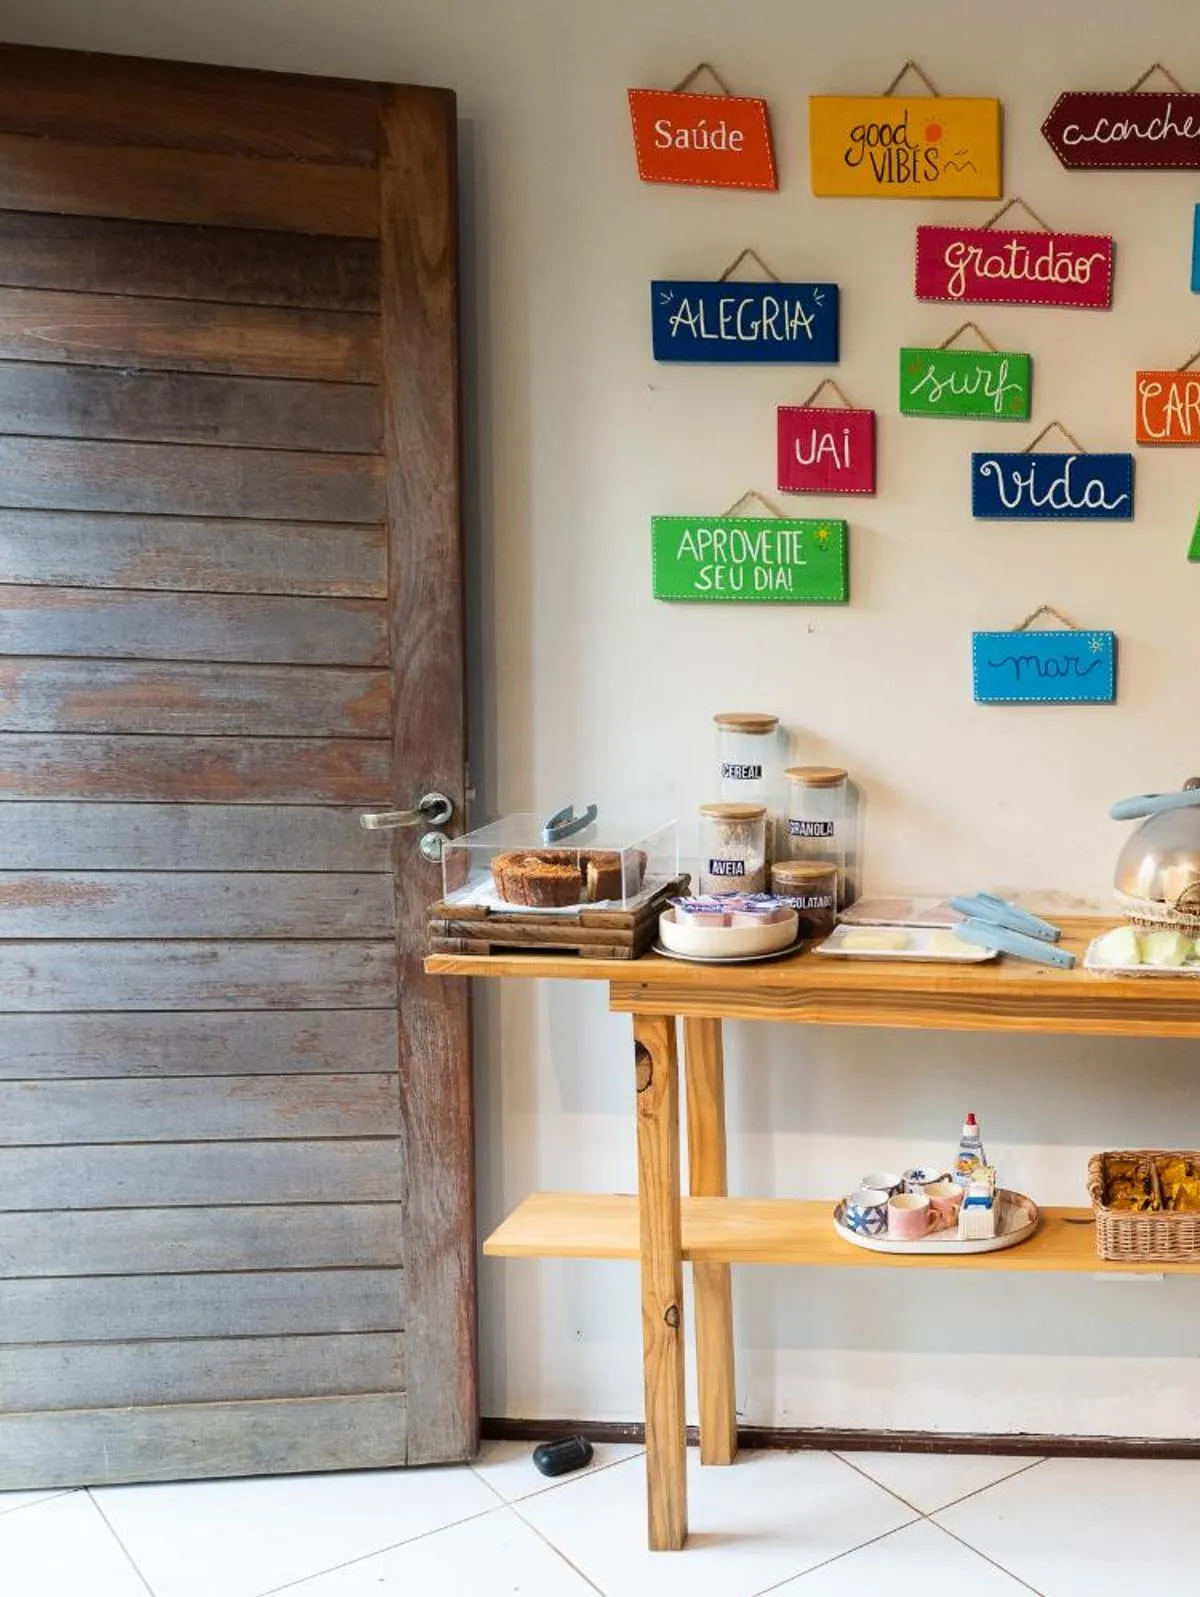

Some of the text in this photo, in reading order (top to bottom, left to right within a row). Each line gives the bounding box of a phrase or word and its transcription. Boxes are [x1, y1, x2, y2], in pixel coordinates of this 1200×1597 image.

[655, 119, 744, 151] Saúde
[844, 109, 918, 167] good
[868, 147, 940, 183] VIBES
[944, 240, 1106, 298] gratidão
[669, 296, 816, 341] ALEGRIA
[676, 528, 808, 565] APROVEITE
[694, 564, 794, 592] SEU DIA!
[721, 763, 760, 780] CEREAL
[711, 860, 744, 875] AVEIA
